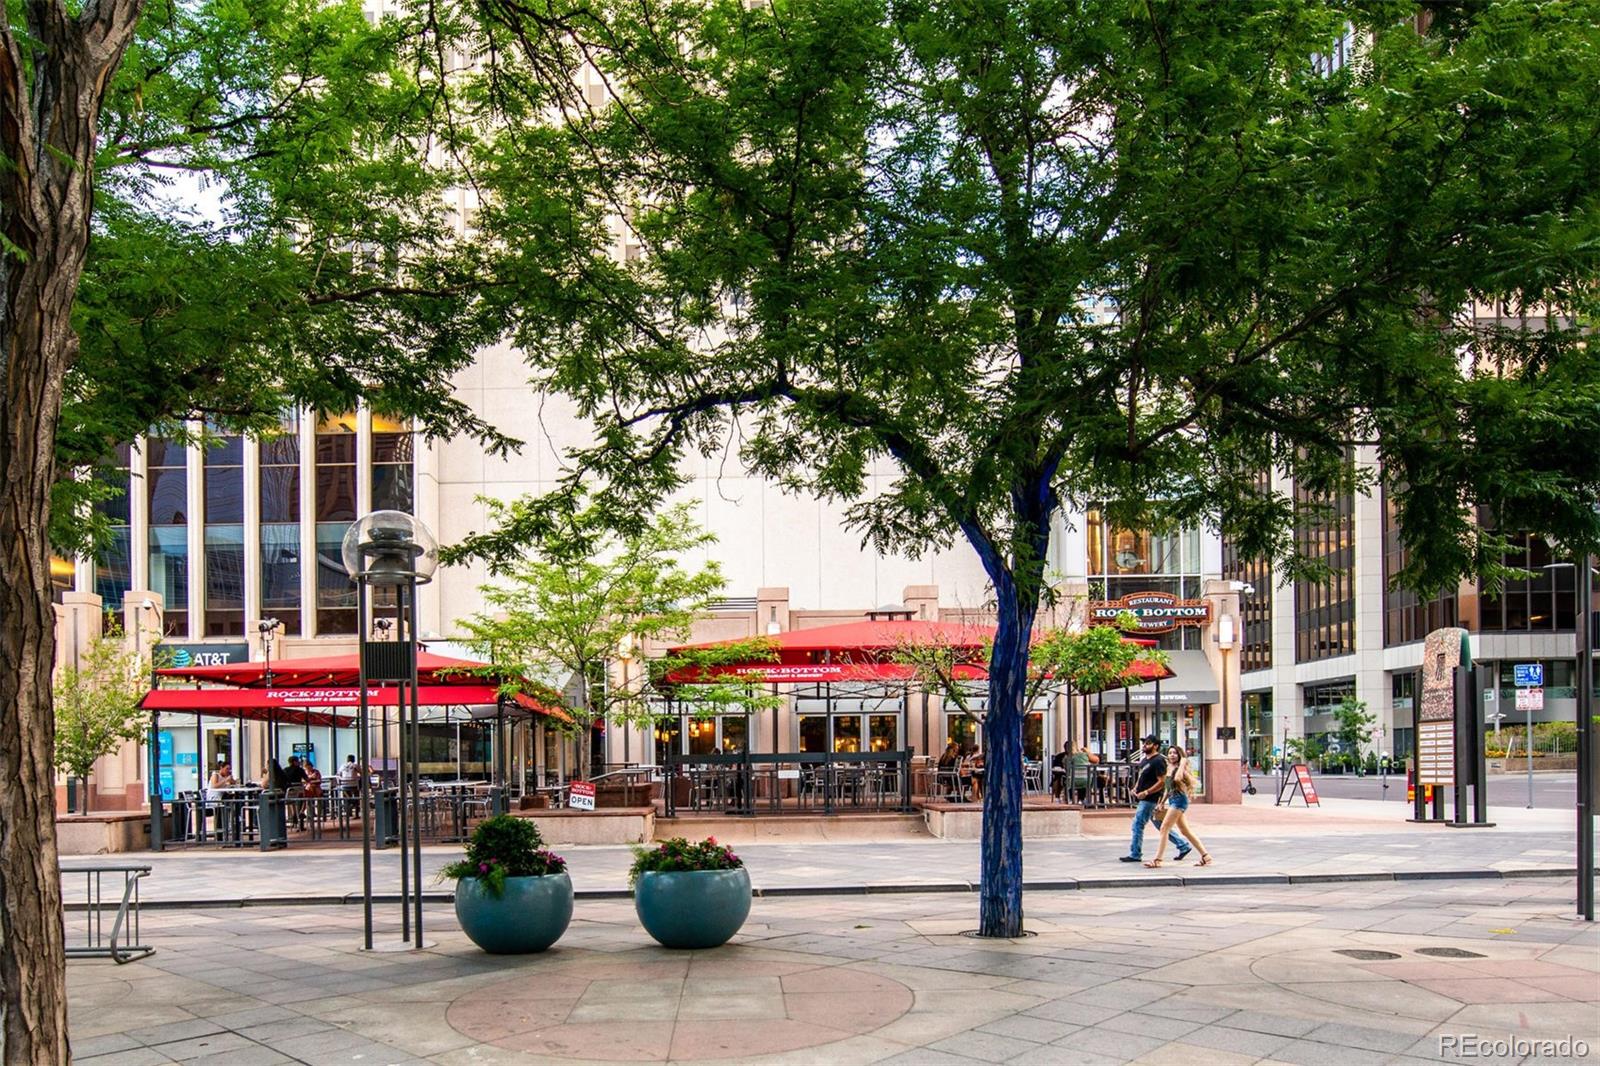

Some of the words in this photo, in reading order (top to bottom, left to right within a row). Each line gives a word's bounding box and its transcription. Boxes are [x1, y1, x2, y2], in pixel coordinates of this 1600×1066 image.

[1128, 598, 1174, 606] RESTAURANT
[1096, 608, 1140, 618] ROCK
[1142, 608, 1207, 616] BOTTOM
[195, 652, 230, 666] AT&T
[572, 796, 592, 806] OPEN
